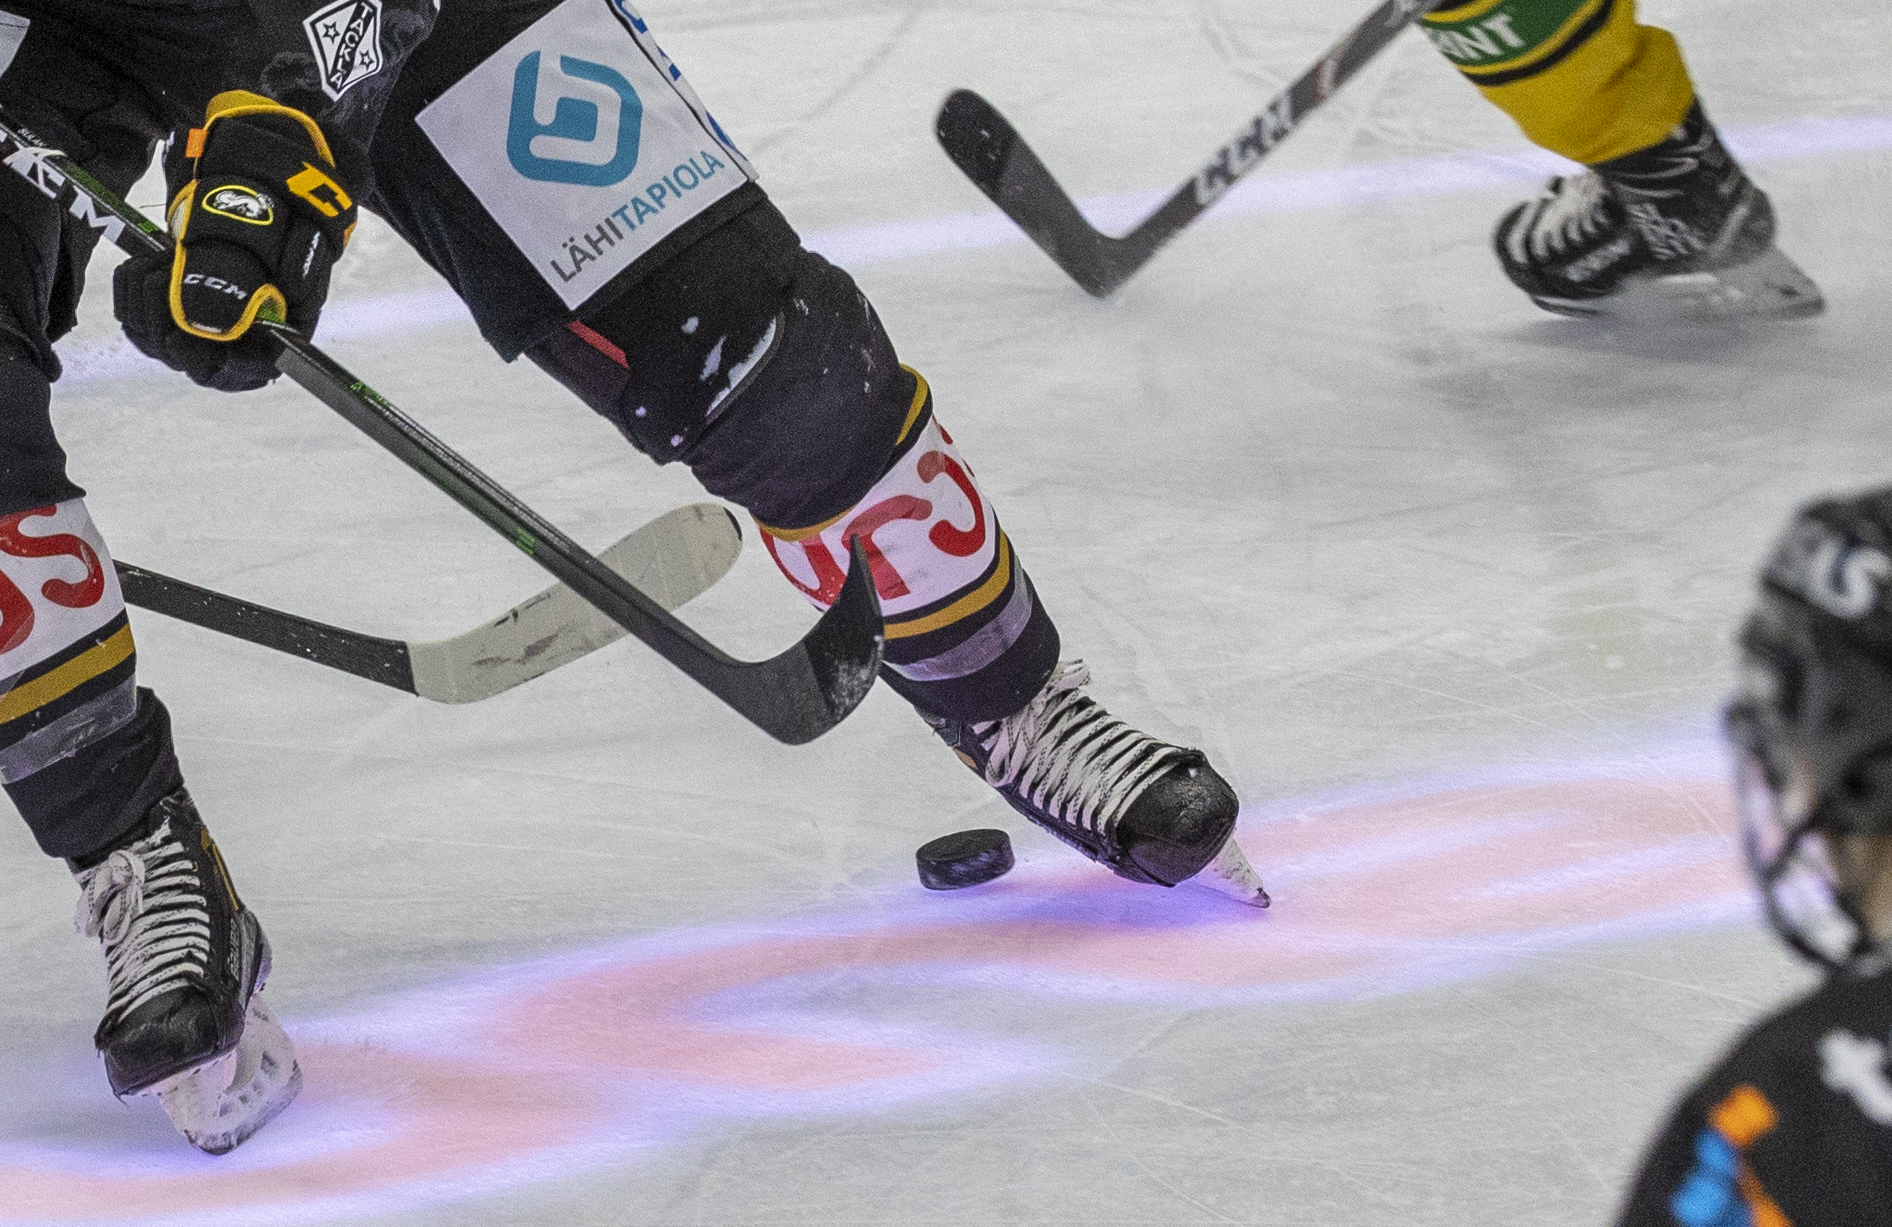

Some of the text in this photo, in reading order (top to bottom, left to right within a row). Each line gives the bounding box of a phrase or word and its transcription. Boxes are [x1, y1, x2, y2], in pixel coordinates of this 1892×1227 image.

[329, 0, 374, 90] TACKLA
[549, 149, 726, 283] LÄHITAPIOLA
[183, 273, 248, 301] CCM
